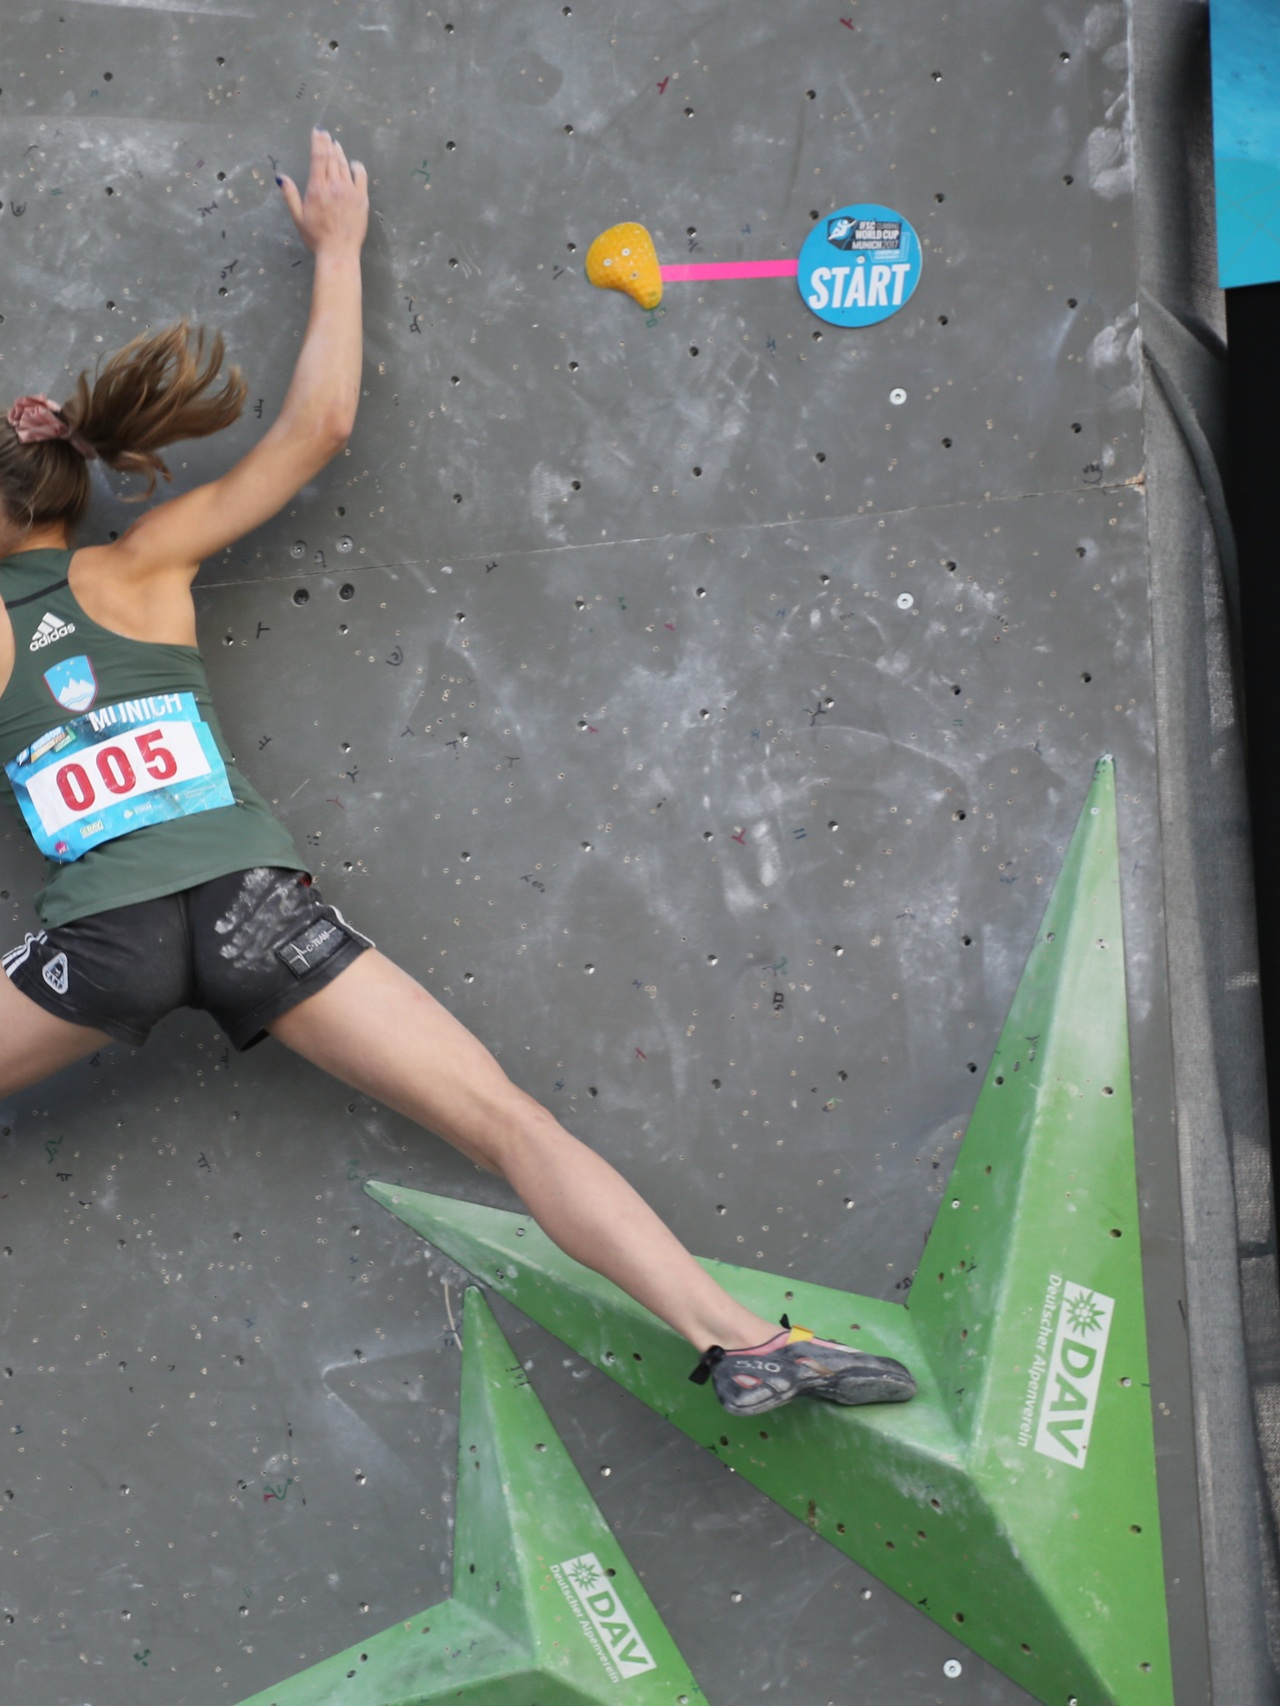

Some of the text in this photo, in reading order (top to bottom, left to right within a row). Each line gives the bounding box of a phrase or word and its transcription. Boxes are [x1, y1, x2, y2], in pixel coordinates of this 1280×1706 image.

[852, 240, 882, 250] MUNICH
[855, 230, 900, 240] WORLD CUP
[809, 263, 911, 310] START
[29, 622, 76, 652] adidas
[56, 729, 178, 811] 005
[1017, 1273, 1063, 1447] Deutscher Alpenverein
[1046, 1337, 1098, 1459] DAV
[549, 1564, 620, 1684] Deutscher Alpenverein
[586, 1590, 649, 1665] DAV
